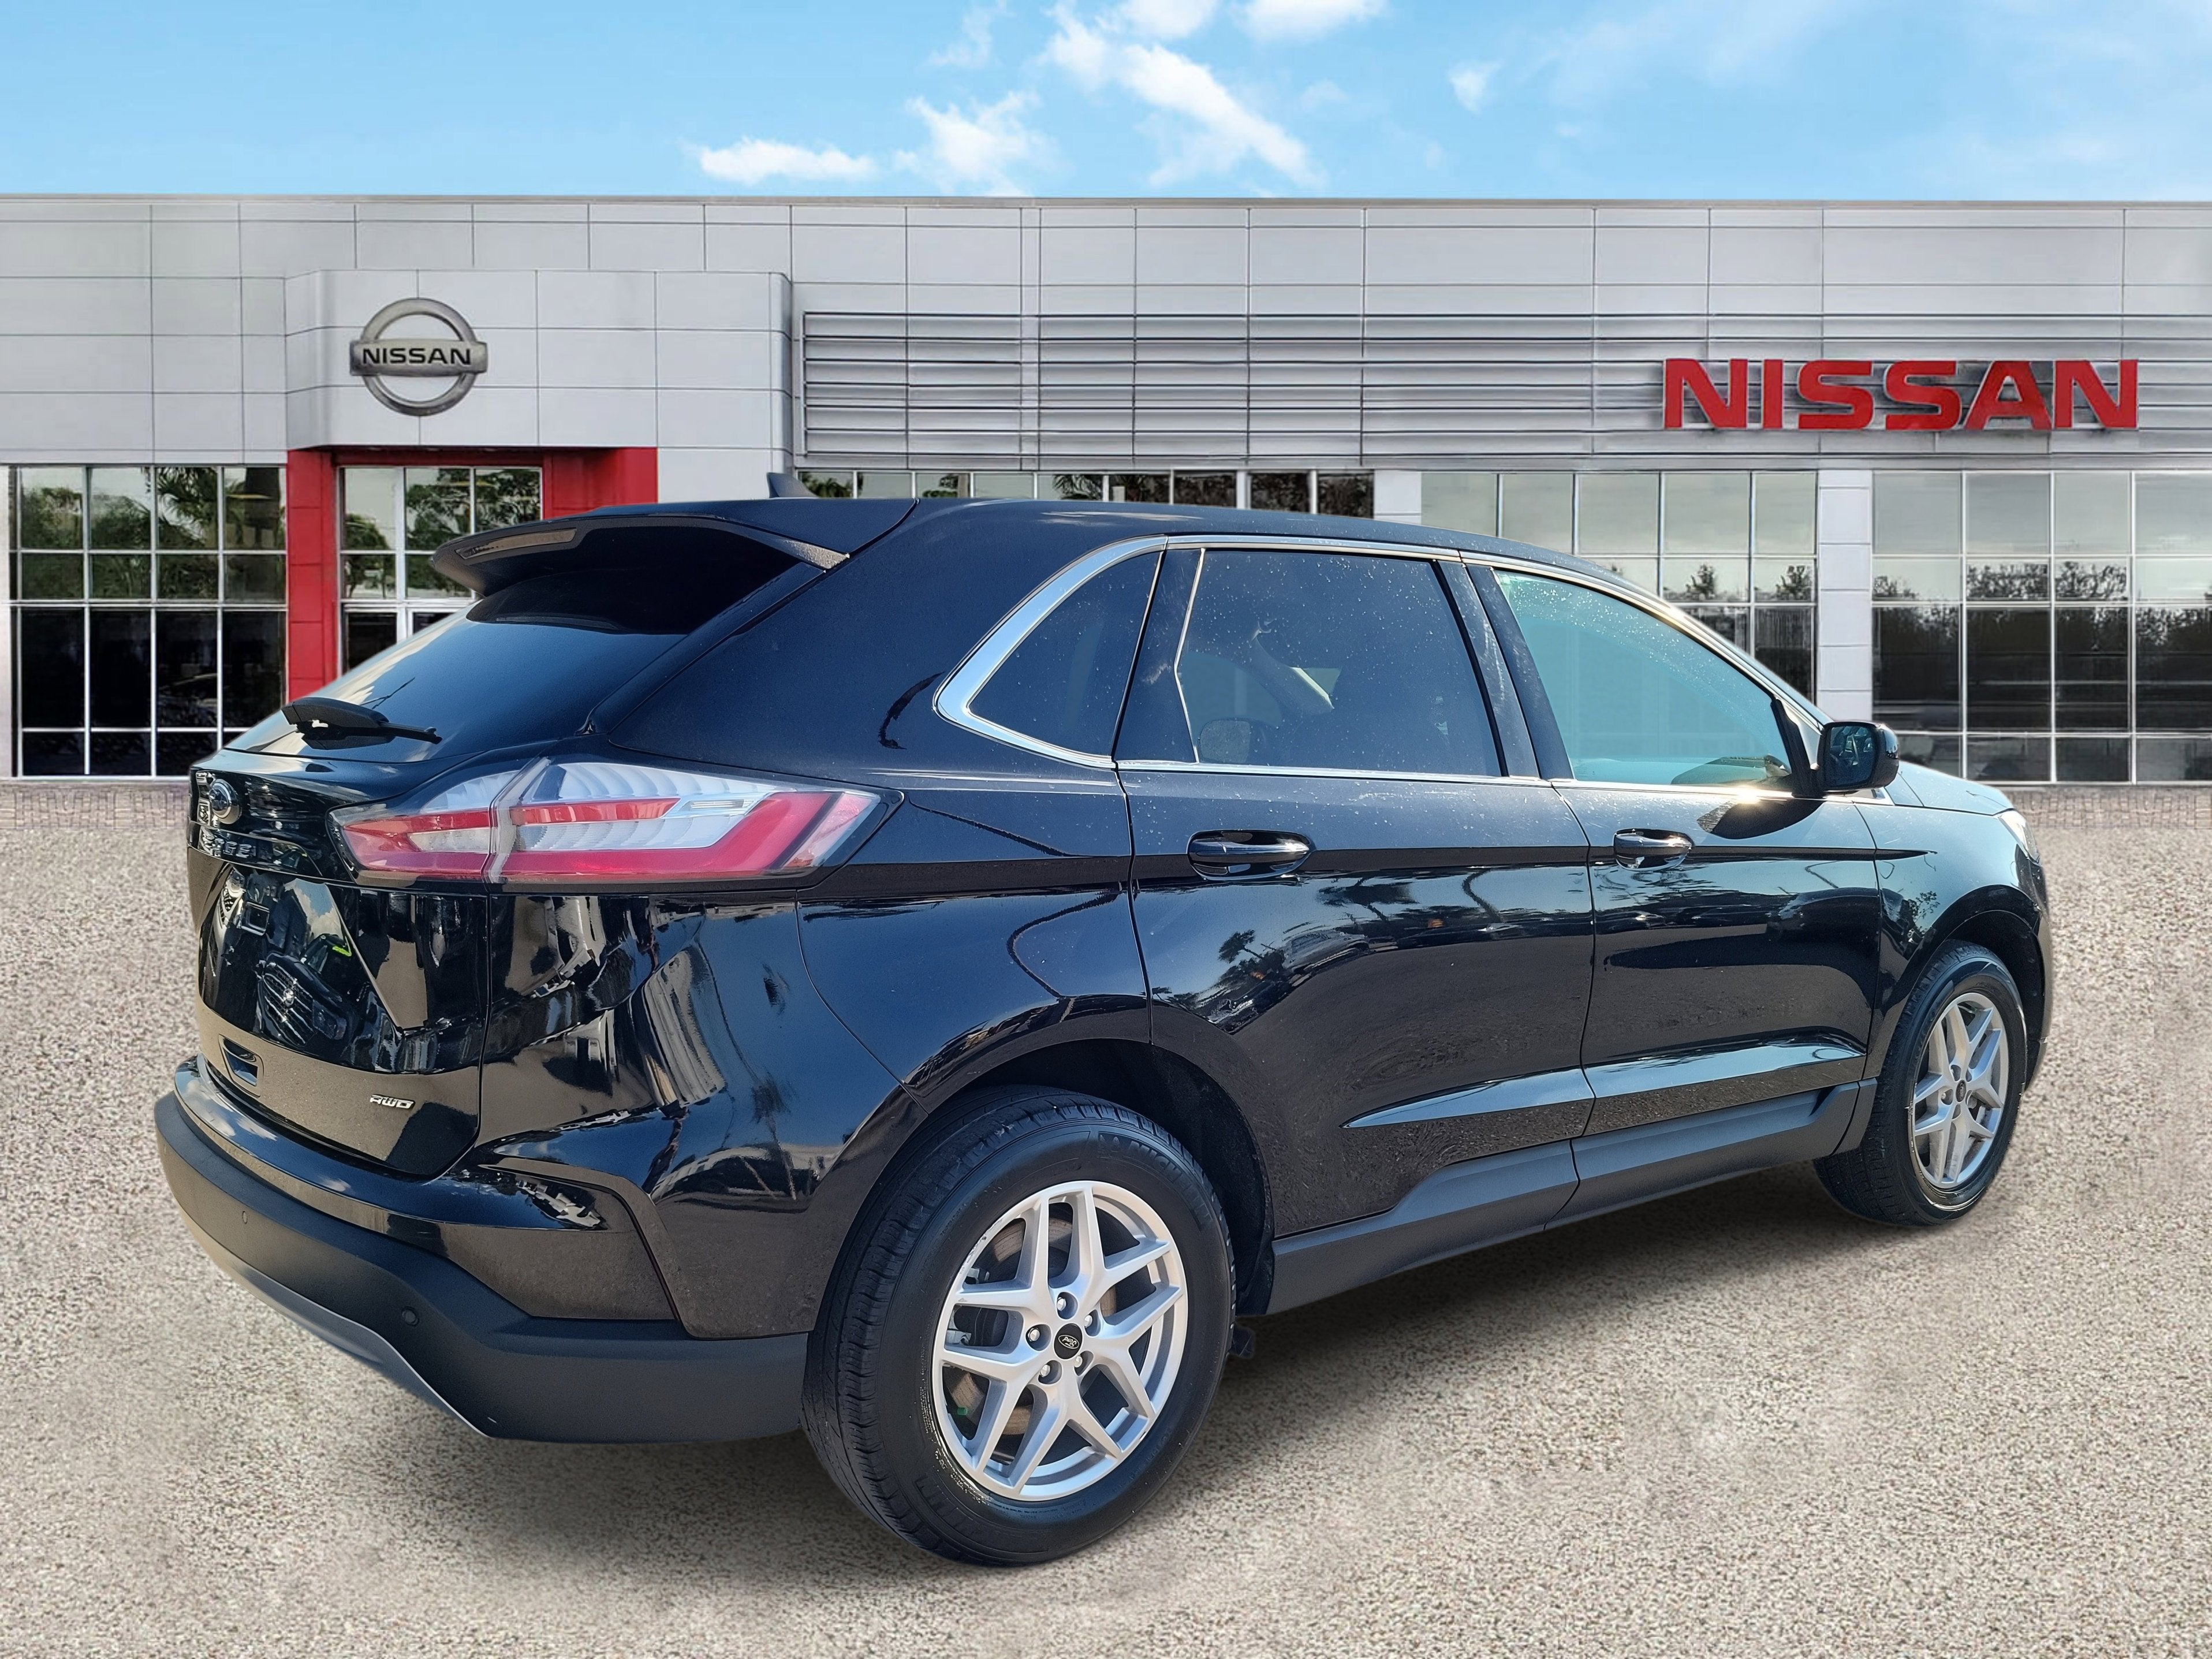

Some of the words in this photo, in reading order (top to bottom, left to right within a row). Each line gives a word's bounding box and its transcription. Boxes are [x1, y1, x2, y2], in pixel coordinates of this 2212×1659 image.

[363, 348, 471, 365] NISSAN
[1663, 358, 2139, 431] NISSAN
[370, 1094, 415, 1109] AWD
